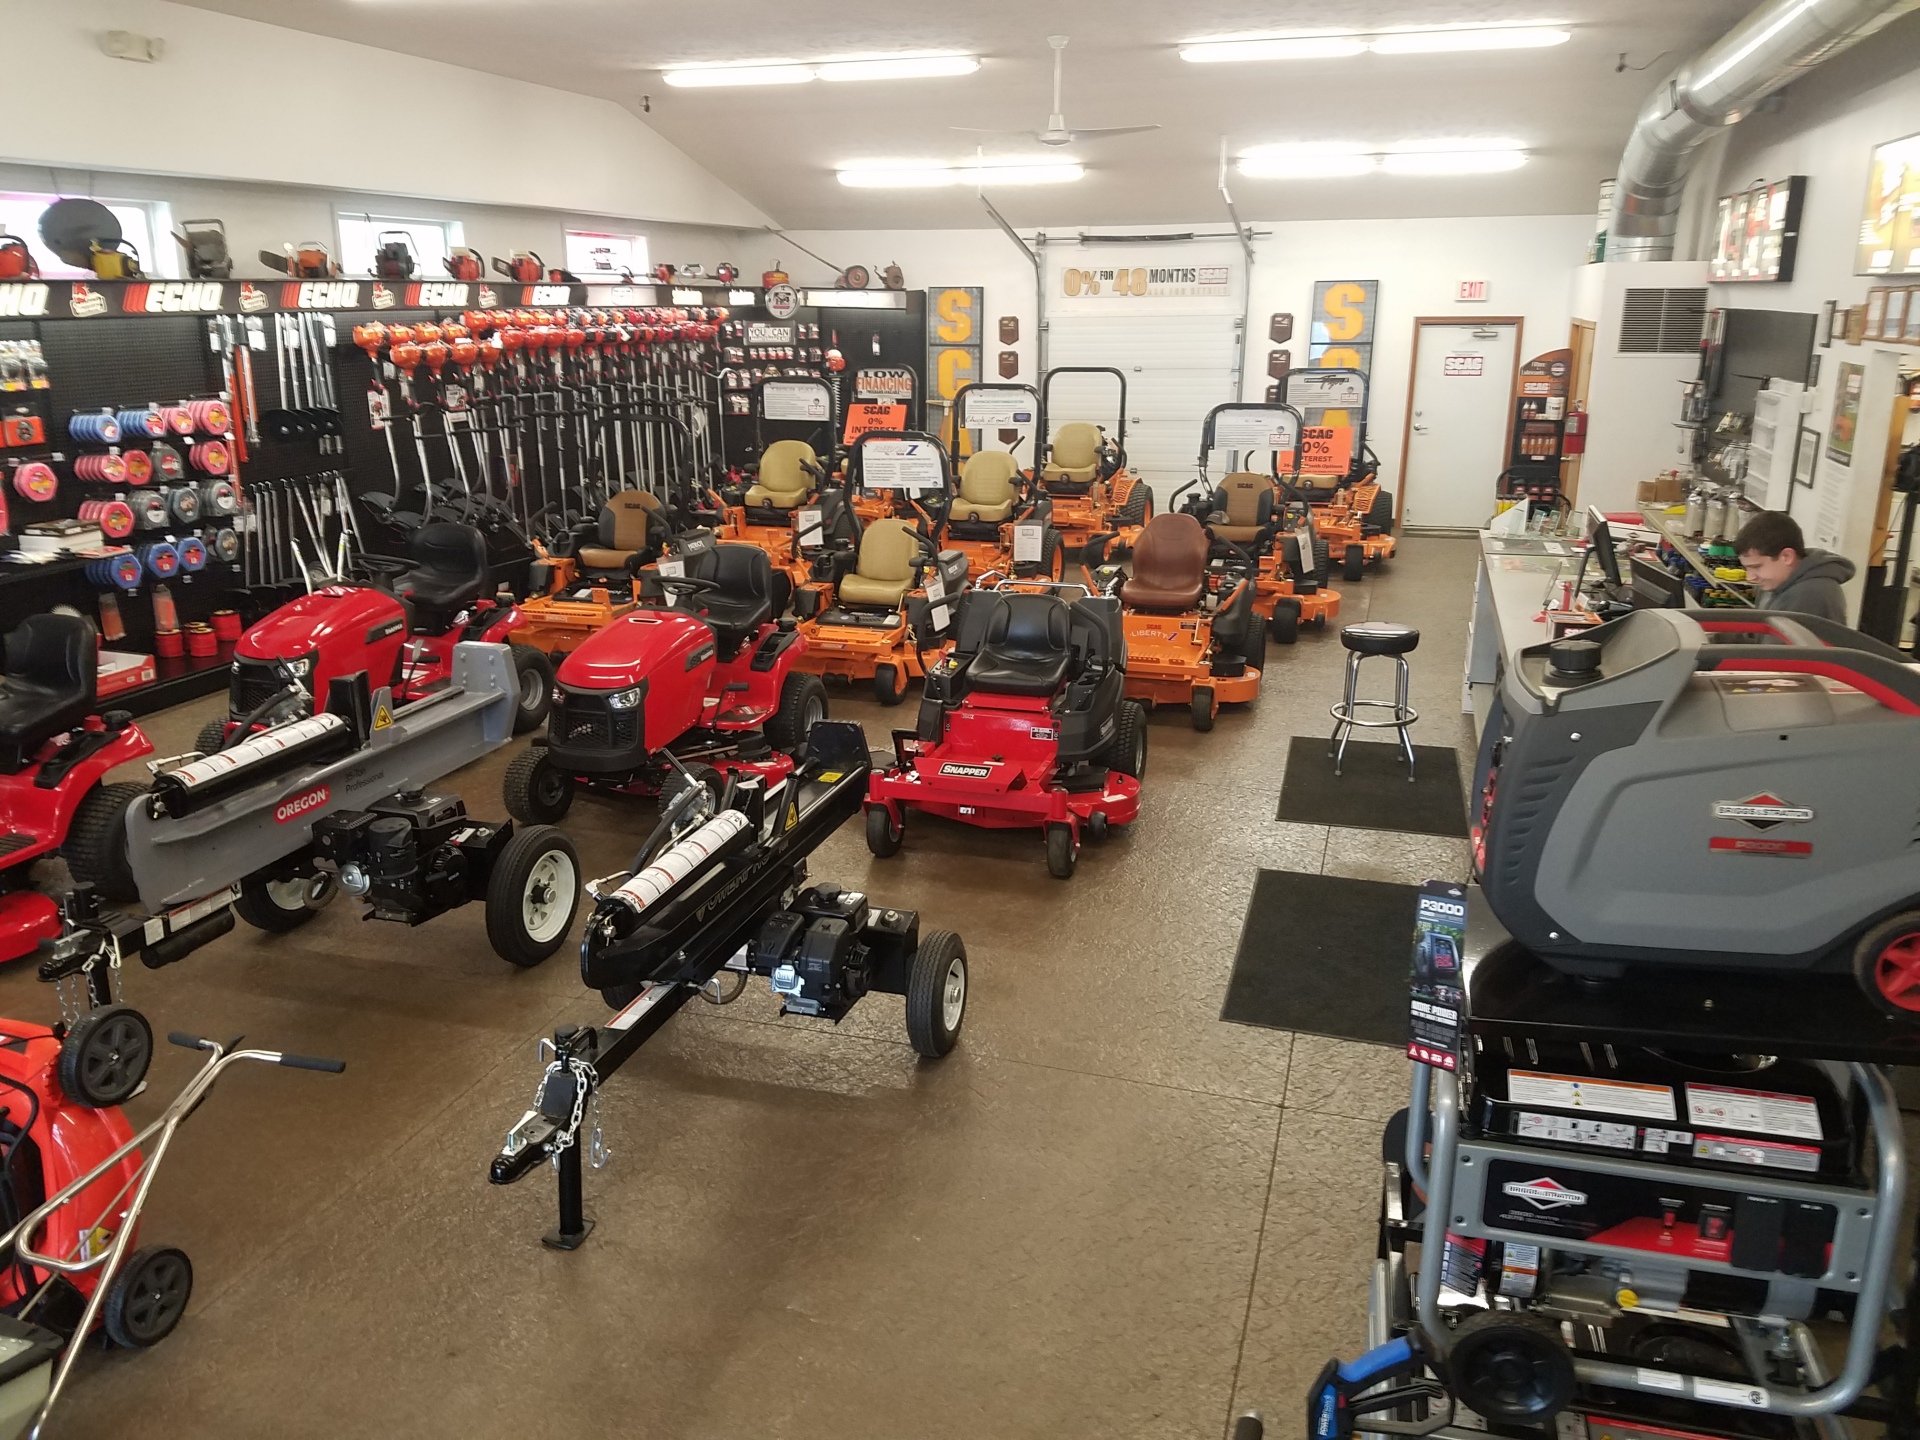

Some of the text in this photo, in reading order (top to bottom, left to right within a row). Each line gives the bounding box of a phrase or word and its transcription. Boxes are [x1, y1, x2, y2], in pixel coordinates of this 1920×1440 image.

[1063, 268, 1100, 296] 0%
[1100, 270, 1114, 281] FOR
[1112, 268, 1148, 296] 48
[1150, 268, 1196, 284] MONTHS
[1460, 281, 1484, 299] EXIT
[0, 283, 48, 316] HO
[145, 282, 223, 313] ECHO
[298, 282, 359, 308] ECHO
[419, 283, 468, 307] ECHO
[749, 328, 789, 336] YOU CAN
[1445, 358, 1482, 370] SCAG
[863, 370, 905, 378] LOW
[857, 378, 912, 391] FINANCING
[863, 406, 890, 415] SCAG
[1302, 441, 1329, 454] 0%
[1131, 630, 1168, 640] LIBERTY
[942, 764, 988, 777] SNAPPER
[345, 769, 385, 793] Professional
[276, 788, 327, 820] OREGON
[1421, 899, 1465, 916] P3000
